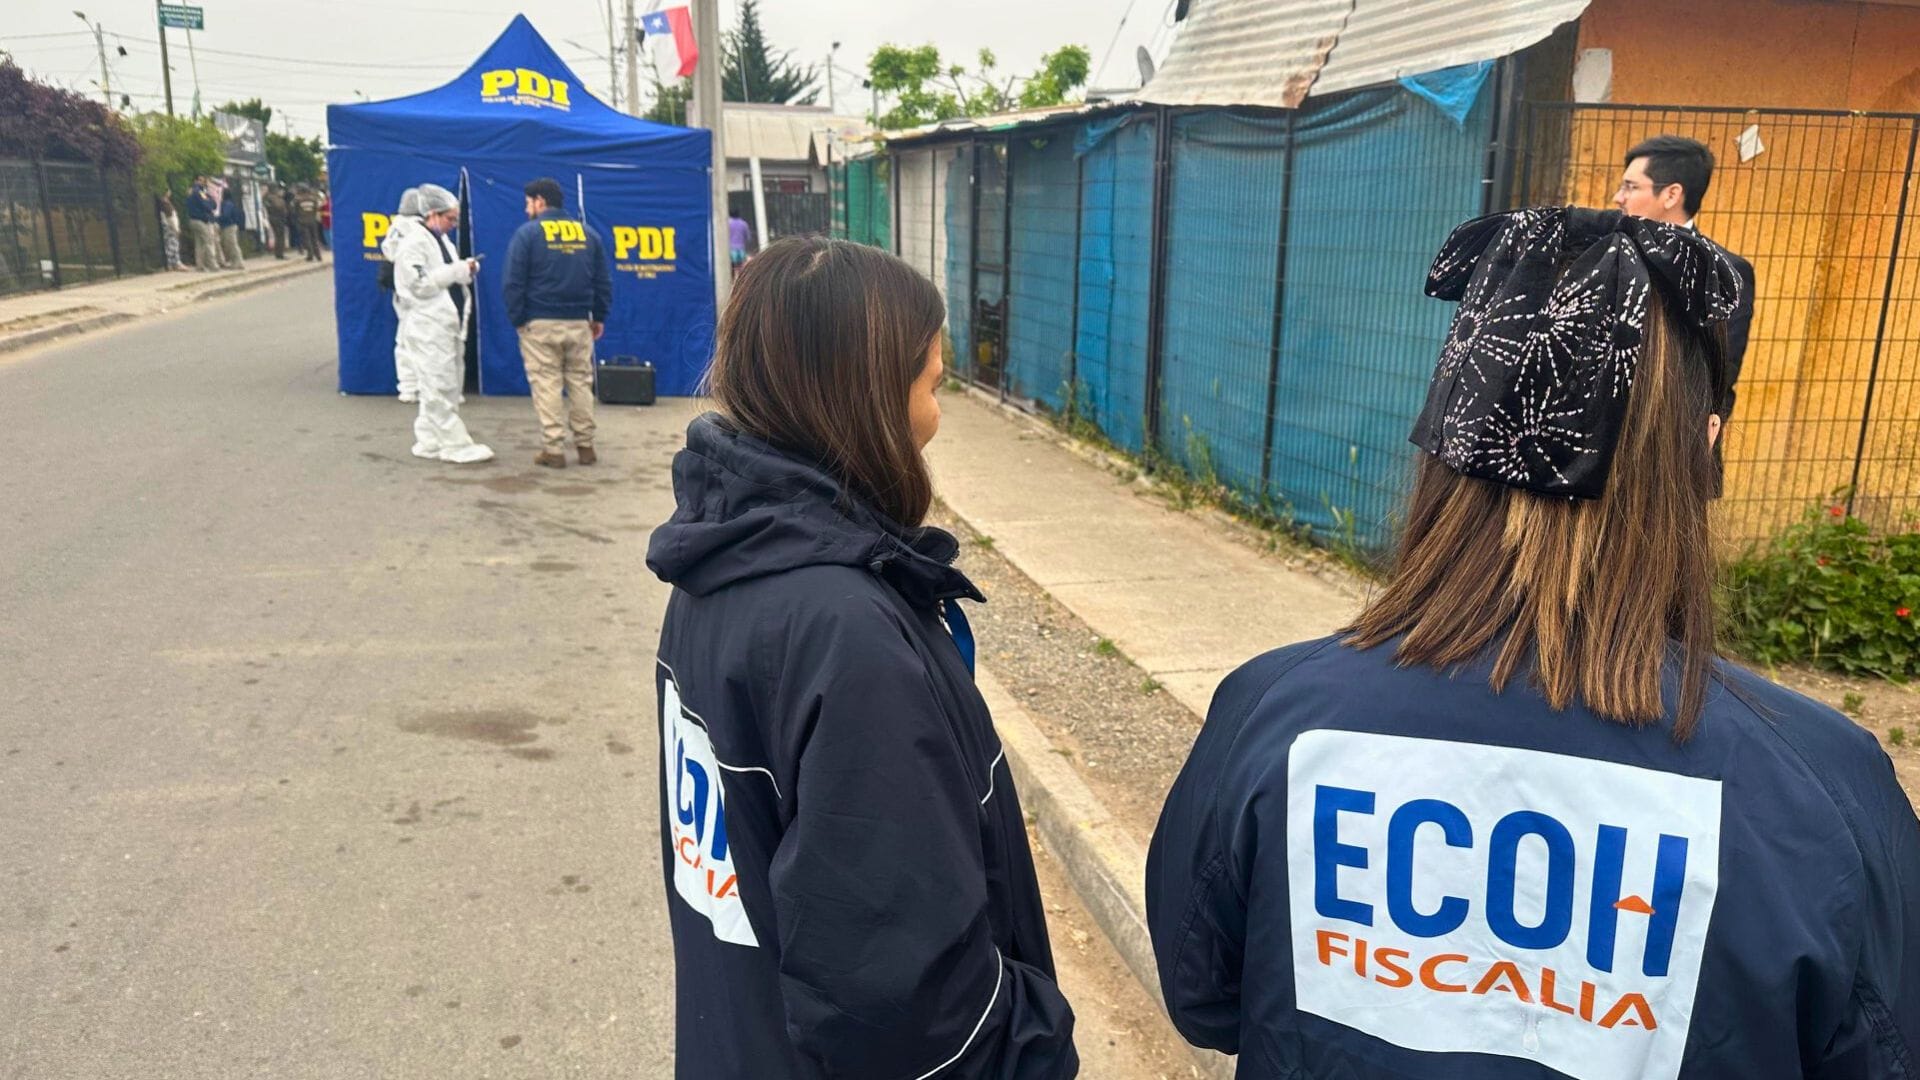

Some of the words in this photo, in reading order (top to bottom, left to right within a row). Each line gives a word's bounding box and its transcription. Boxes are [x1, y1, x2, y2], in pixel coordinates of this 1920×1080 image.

[481, 68, 570, 105] PDI
[541, 220, 587, 242] PDI
[612, 226, 677, 260] PDI
[1313, 785, 1688, 977] ECOH
[1316, 930, 1657, 1030] FISCALIA
